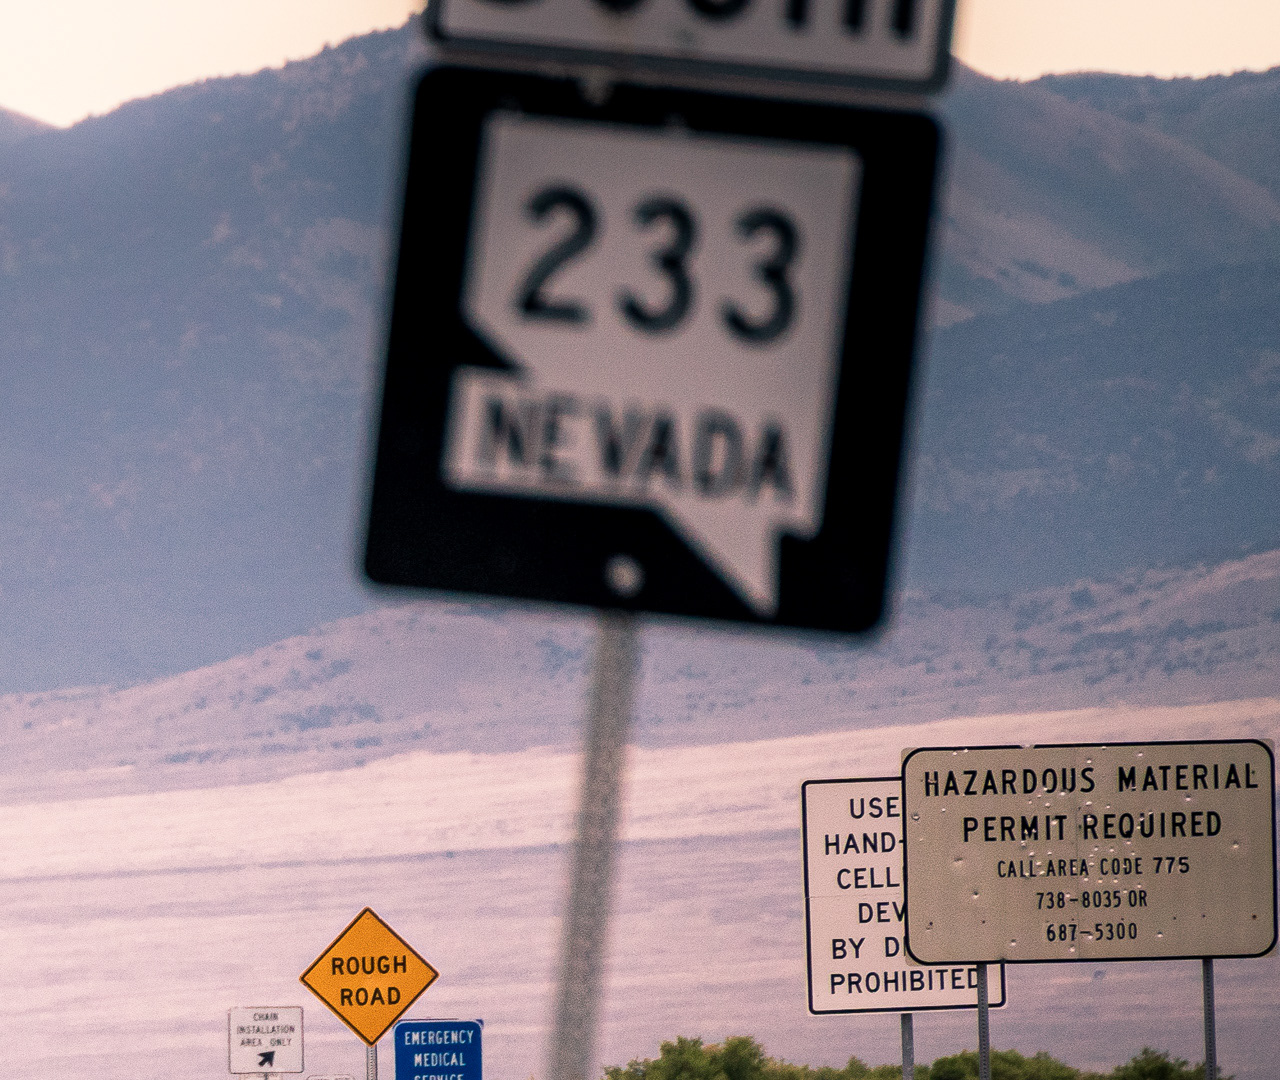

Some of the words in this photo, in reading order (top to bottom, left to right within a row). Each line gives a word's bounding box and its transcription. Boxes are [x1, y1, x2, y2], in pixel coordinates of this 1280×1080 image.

[518, 185, 800, 343] 233
[477, 392, 793, 500] NEVADA
[924, 766, 1095, 797] HAZARDOUS
[1118, 763, 1258, 792] MATERIAL
[850, 797, 900, 819] USE
[963, 815, 1067, 843] PERMIT
[1083, 811, 1222, 840] REQUIRED
[997, 860, 1037, 879] CALL
[1047, 858, 1090, 877] AREA
[1100, 857, 1143, 876] CODE
[1153, 856, 1190, 874] 775
[1036, 890, 1122, 909] 738-8035
[1127, 890, 1148, 907] OR
[1047, 923, 1138, 942] 687-5300
[832, 937, 865, 960] BY
[331, 955, 408, 976] ROUGH
[830, 968, 978, 995] PROHIBITED
[340, 987, 401, 1007] ROAD
[253, 1013, 279, 1022] CHAIN
[237, 1025, 295, 1035] INSTALLATION
[404, 1030, 475, 1046] EMERGENCY
[240, 1038, 262, 1047] AREA
[269, 1038, 292, 1047] ONLY
[414, 1053, 467, 1068] MEDICAL
